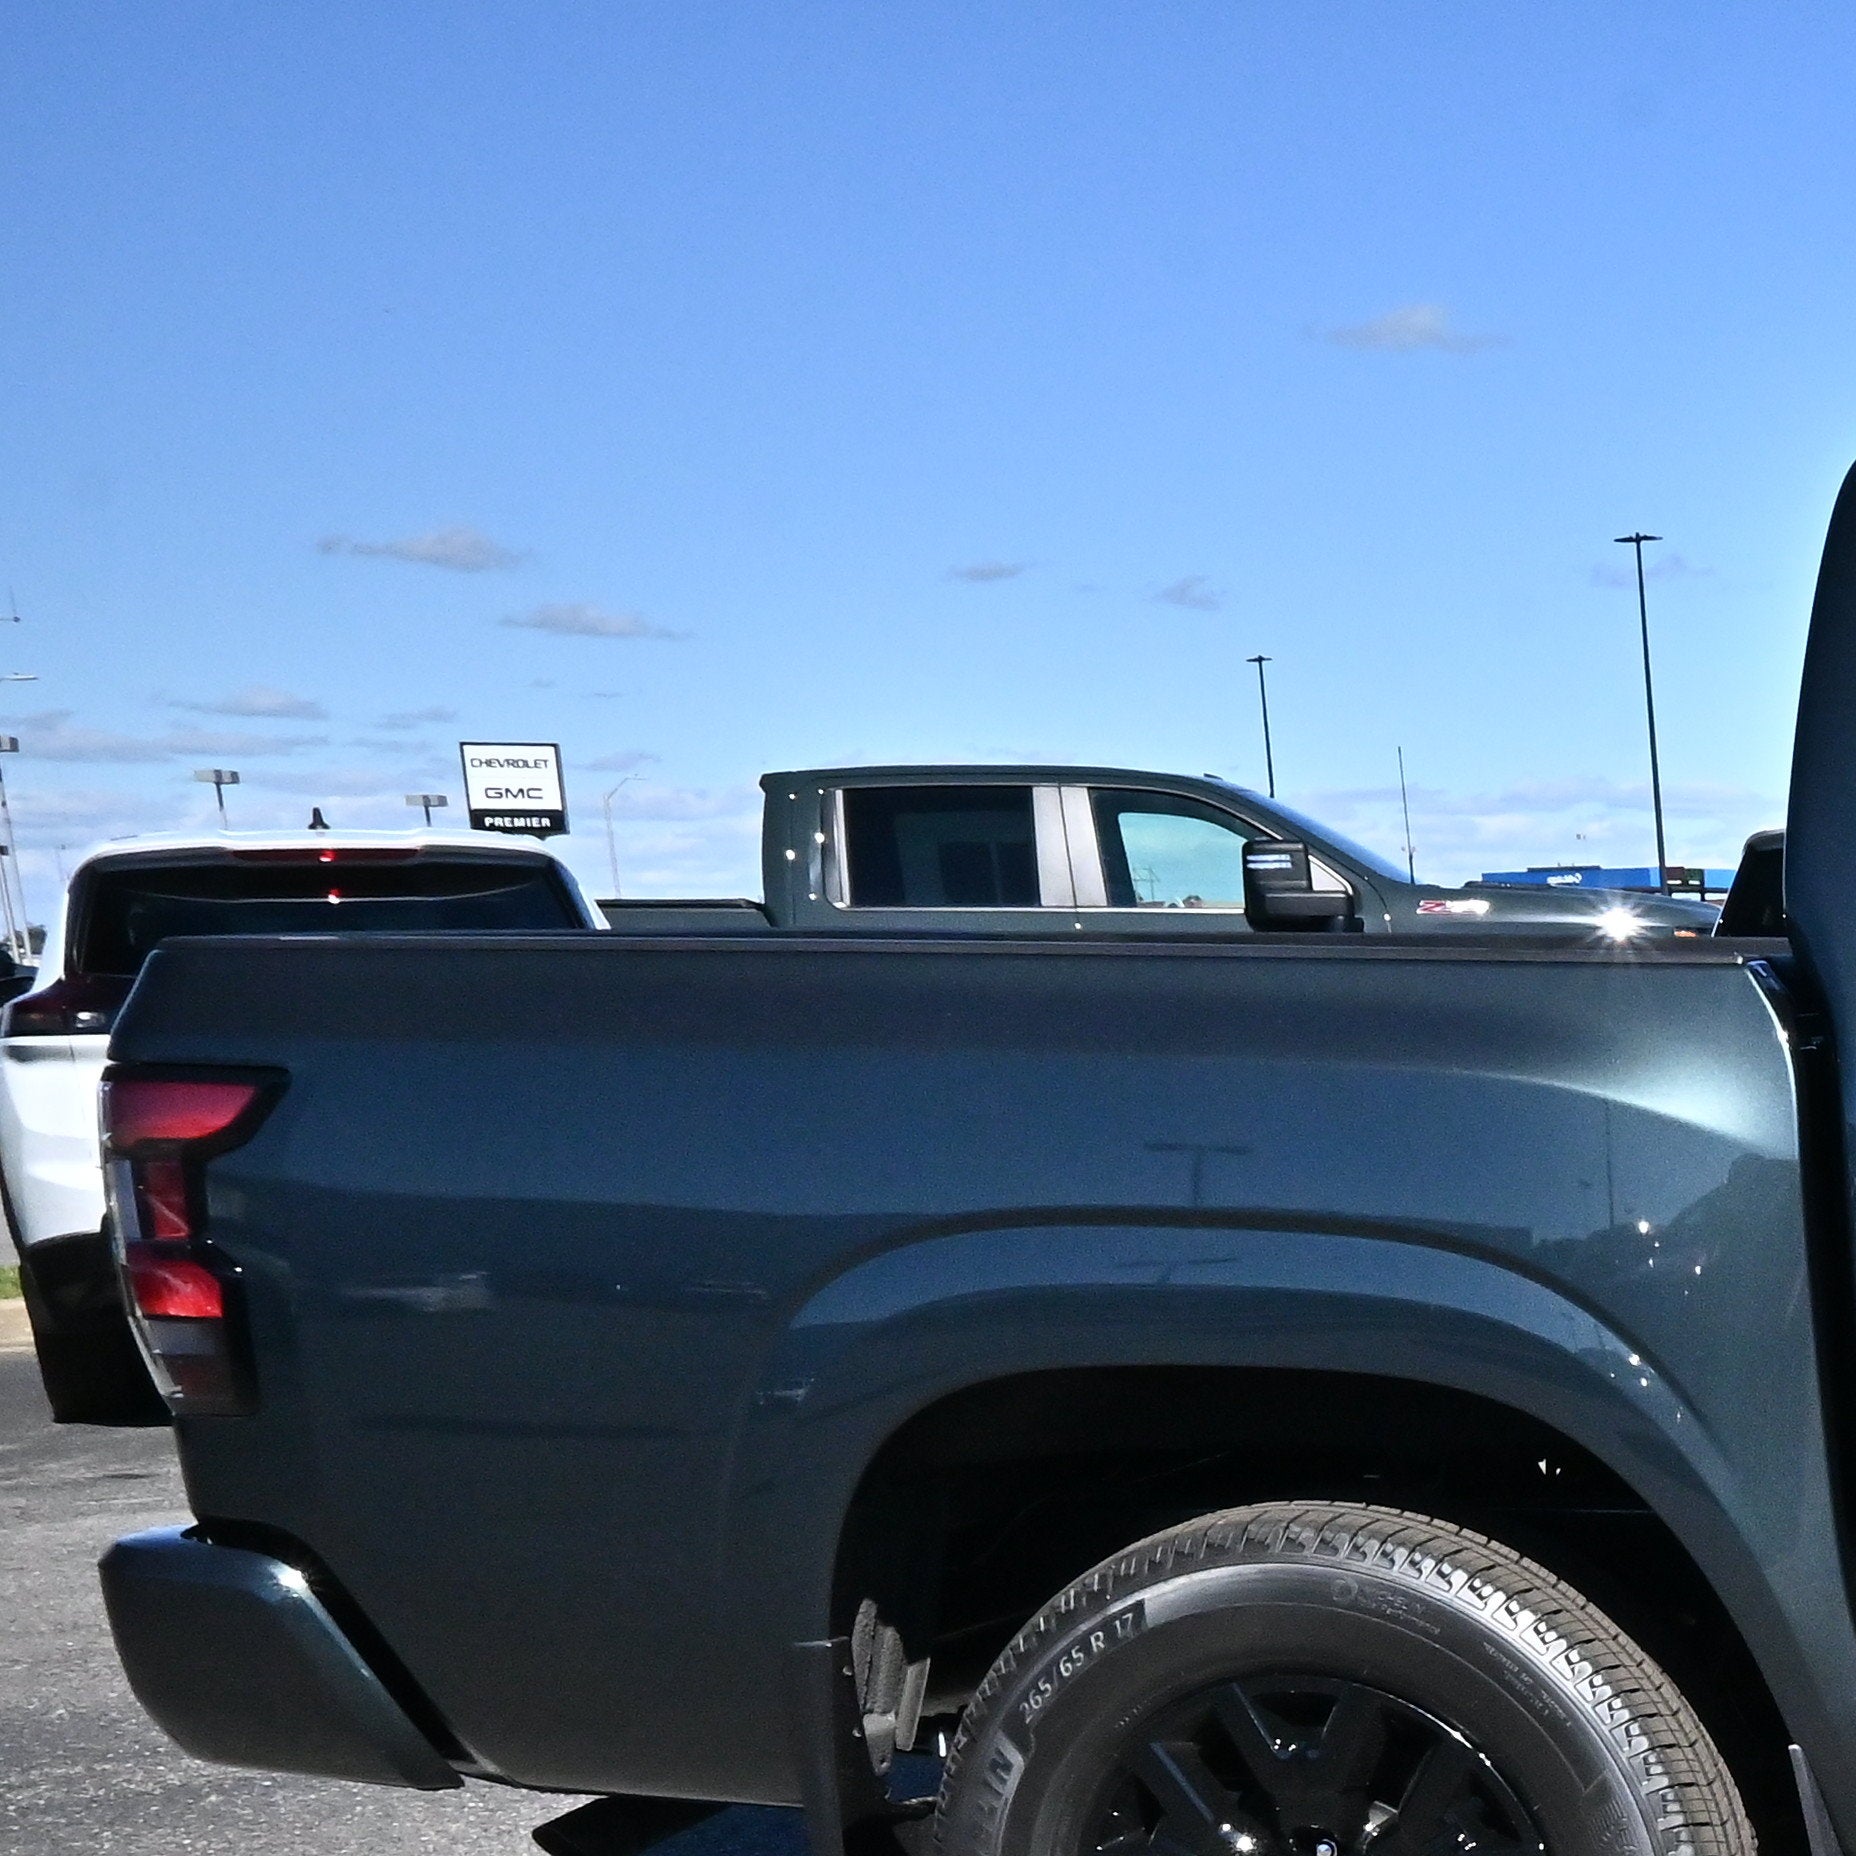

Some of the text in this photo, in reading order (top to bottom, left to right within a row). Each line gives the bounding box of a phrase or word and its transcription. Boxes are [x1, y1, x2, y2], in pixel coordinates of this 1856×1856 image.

[470, 758, 549, 769] CHEVROLET
[485, 787, 543, 800] GMC
[484, 816, 551, 828] PREMIER
[1019, 1644, 1085, 1725] 265/65
[1089, 1630, 1106, 1653] R
[1113, 1612, 1134, 1639] 17
